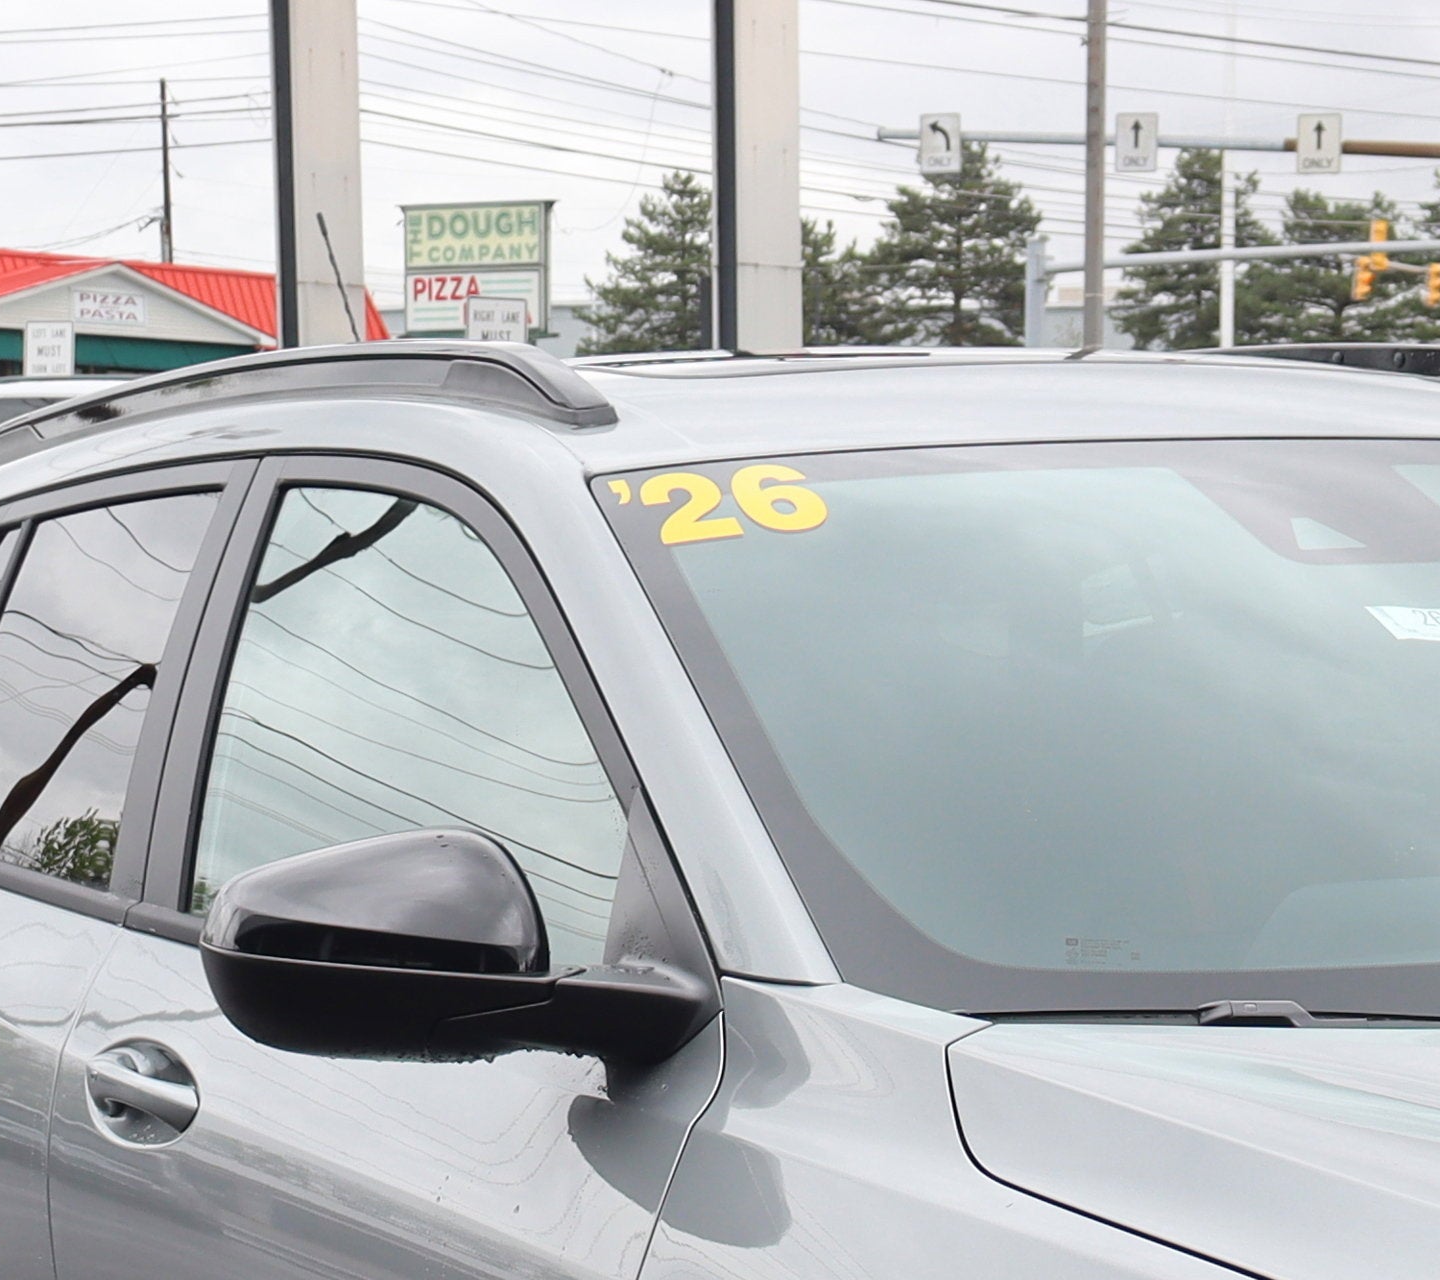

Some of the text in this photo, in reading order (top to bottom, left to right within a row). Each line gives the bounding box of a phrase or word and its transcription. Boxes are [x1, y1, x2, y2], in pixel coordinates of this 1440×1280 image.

[928, 156, 953, 167] ONLY
[1122, 156, 1149, 167] ONLY
[1302, 157, 1334, 168] ONLY
[426, 208, 538, 240] DOUGH
[408, 214, 423, 263] THE
[427, 242, 538, 262] COMPANY
[413, 275, 481, 302] PIZZA
[79, 292, 137, 306] PIZZA
[79, 308, 138, 321] PASTA
[473, 311, 495, 323] RIGHT
[501, 311, 520, 324] LANE
[36, 345, 62, 357] MUST
